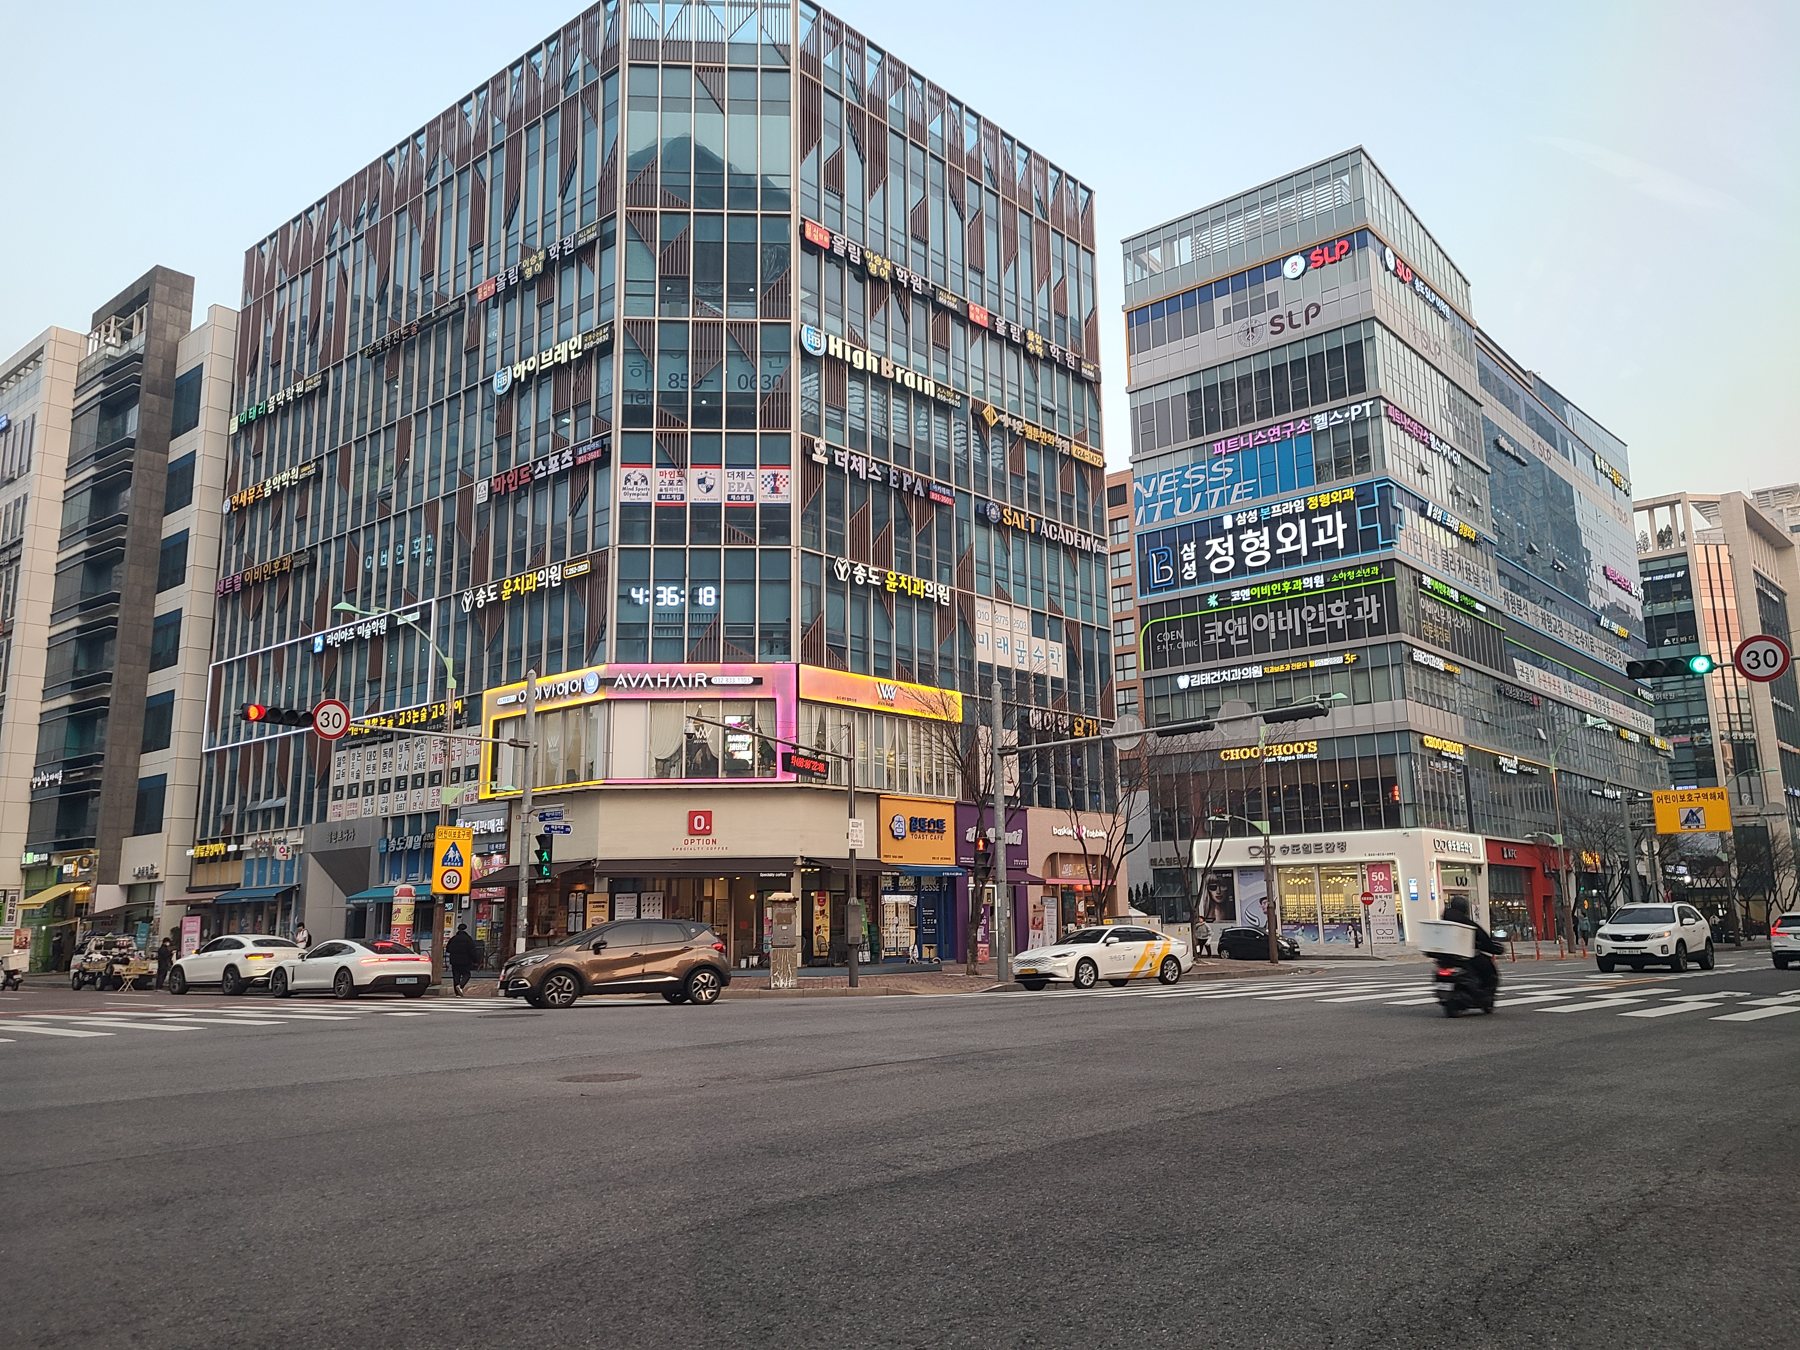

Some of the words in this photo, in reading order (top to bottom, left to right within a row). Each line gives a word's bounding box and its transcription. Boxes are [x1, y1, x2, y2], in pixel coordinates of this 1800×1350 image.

[495, 265, 520, 293] 올림
[547, 235, 575, 261] 학원
[831, 235, 861, 266] 올림
[895, 266, 922, 295] 학원
[1310, 239, 1351, 268] SLP
[1269, 302, 1321, 335] SLP
[513, 334, 582, 382] 하이브레인
[994, 317, 1021, 343] 올림
[1049, 344, 1075, 370] 학원
[828, 333, 935, 398] HighBrain
[1211, 418, 1312, 456] 피트니스연구소
[492, 466, 531, 495] 마인드
[534, 450, 573, 480] 스포츠
[727, 470, 755, 480] 더체스
[833, 450, 882, 482] 더체스
[888, 468, 925, 497] EPA
[728, 482, 754, 493] EPA
[1235, 508, 1258, 525] 삼성
[1259, 498, 1305, 520] 본프라임
[1306, 487, 1355, 510] 정형외과
[1002, 508, 1038, 533] SALT
[1040, 521, 1099, 554] ACADEMY
[1180, 540, 1196, 581] 삼성
[1203, 510, 1347, 574] 정형외과
[475, 584, 498, 608] 송도
[501, 564, 561, 600] 윤치과의원
[853, 563, 882, 585] 송도
[885, 571, 950, 606] 윤치과의원
[1331, 566, 1380, 583] 소아청소년과
[631, 586, 716, 606] 4:36:18
[357, 616, 387, 639] 미술학원
[976, 609, 989, 621] 010
[1155, 629, 1183, 643] COEN
[977, 631, 1062, 672] 미래꿈수학
[1745, 649, 1777, 670] 30
[614, 672, 708, 688] AVAHAIR
[1188, 665, 1262, 687] 김태건치과의원
[1343, 653, 1357, 664] 3F
[320, 711, 340, 729] 30
[398, 707, 427, 726] 고3논술
[432, 699, 463, 719] 고3어
[1220, 747, 1261, 761] CHOO
[1263, 740, 1318, 756] CHOO'S
[1656, 790, 1725, 804] 어린이보호구역해제
[387, 837, 422, 852] 송도제일
[684, 838, 717, 846] OPTION
[446, 876, 458, 885] 30
